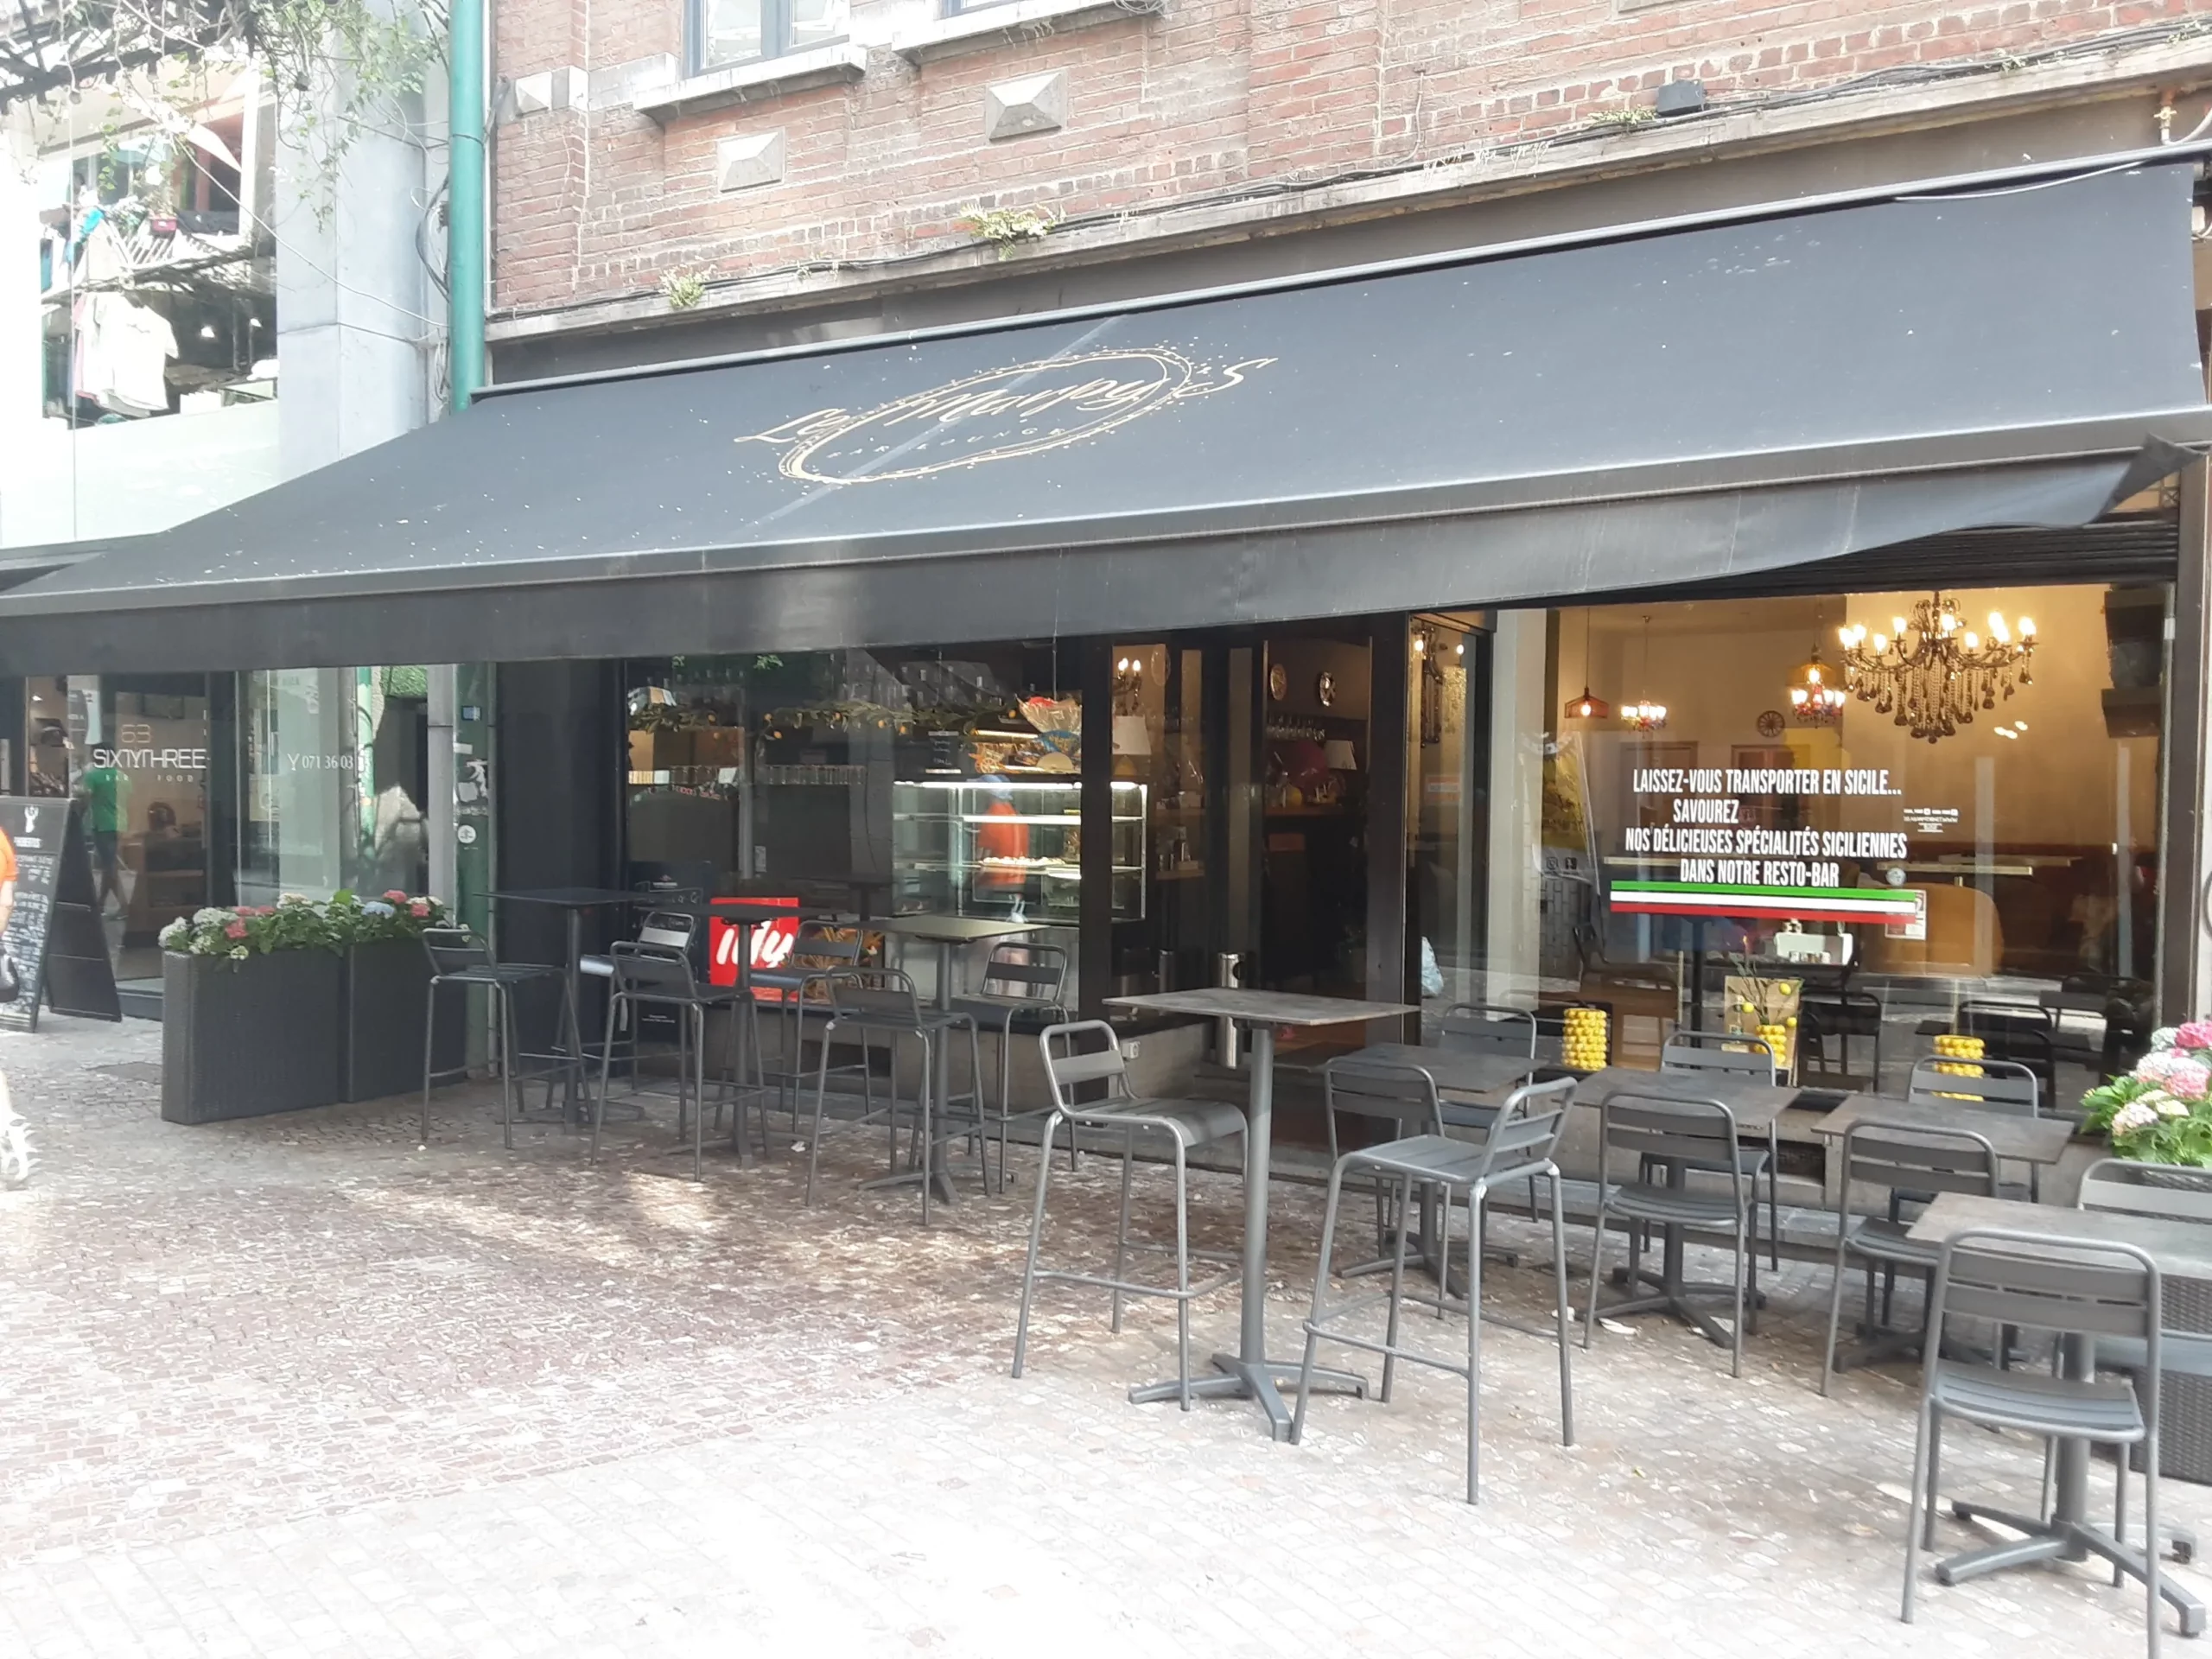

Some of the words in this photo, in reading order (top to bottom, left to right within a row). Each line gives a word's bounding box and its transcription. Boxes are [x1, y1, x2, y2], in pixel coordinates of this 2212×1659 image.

[121, 724, 150, 743] 63
[92, 748, 207, 769] SIXTYTHREE
[302, 755, 321, 769] 071
[324, 755, 338, 769] 36
[340, 755, 354, 769] 03
[1633, 768, 1723, 793] LAISSEZ-VOUS
[1726, 769, 1820, 794] TRANSPORTER
[1822, 769, 1841, 794] EN
[1844, 769, 1902, 795] SICILE...
[1673, 798, 1739, 823] SAVOUREZ
[1625, 827, 1651, 852] NOS
[1653, 823, 1733, 854] DÉLICIEUSES
[1735, 824, 1820, 856] SPÉCIALITÉS
[1821, 831, 1908, 858] SICILIENNES
[1680, 858, 1714, 883] DANS
[1717, 860, 1761, 885] NOTRE
[1763, 861, 1840, 887] RESTO-BAR
